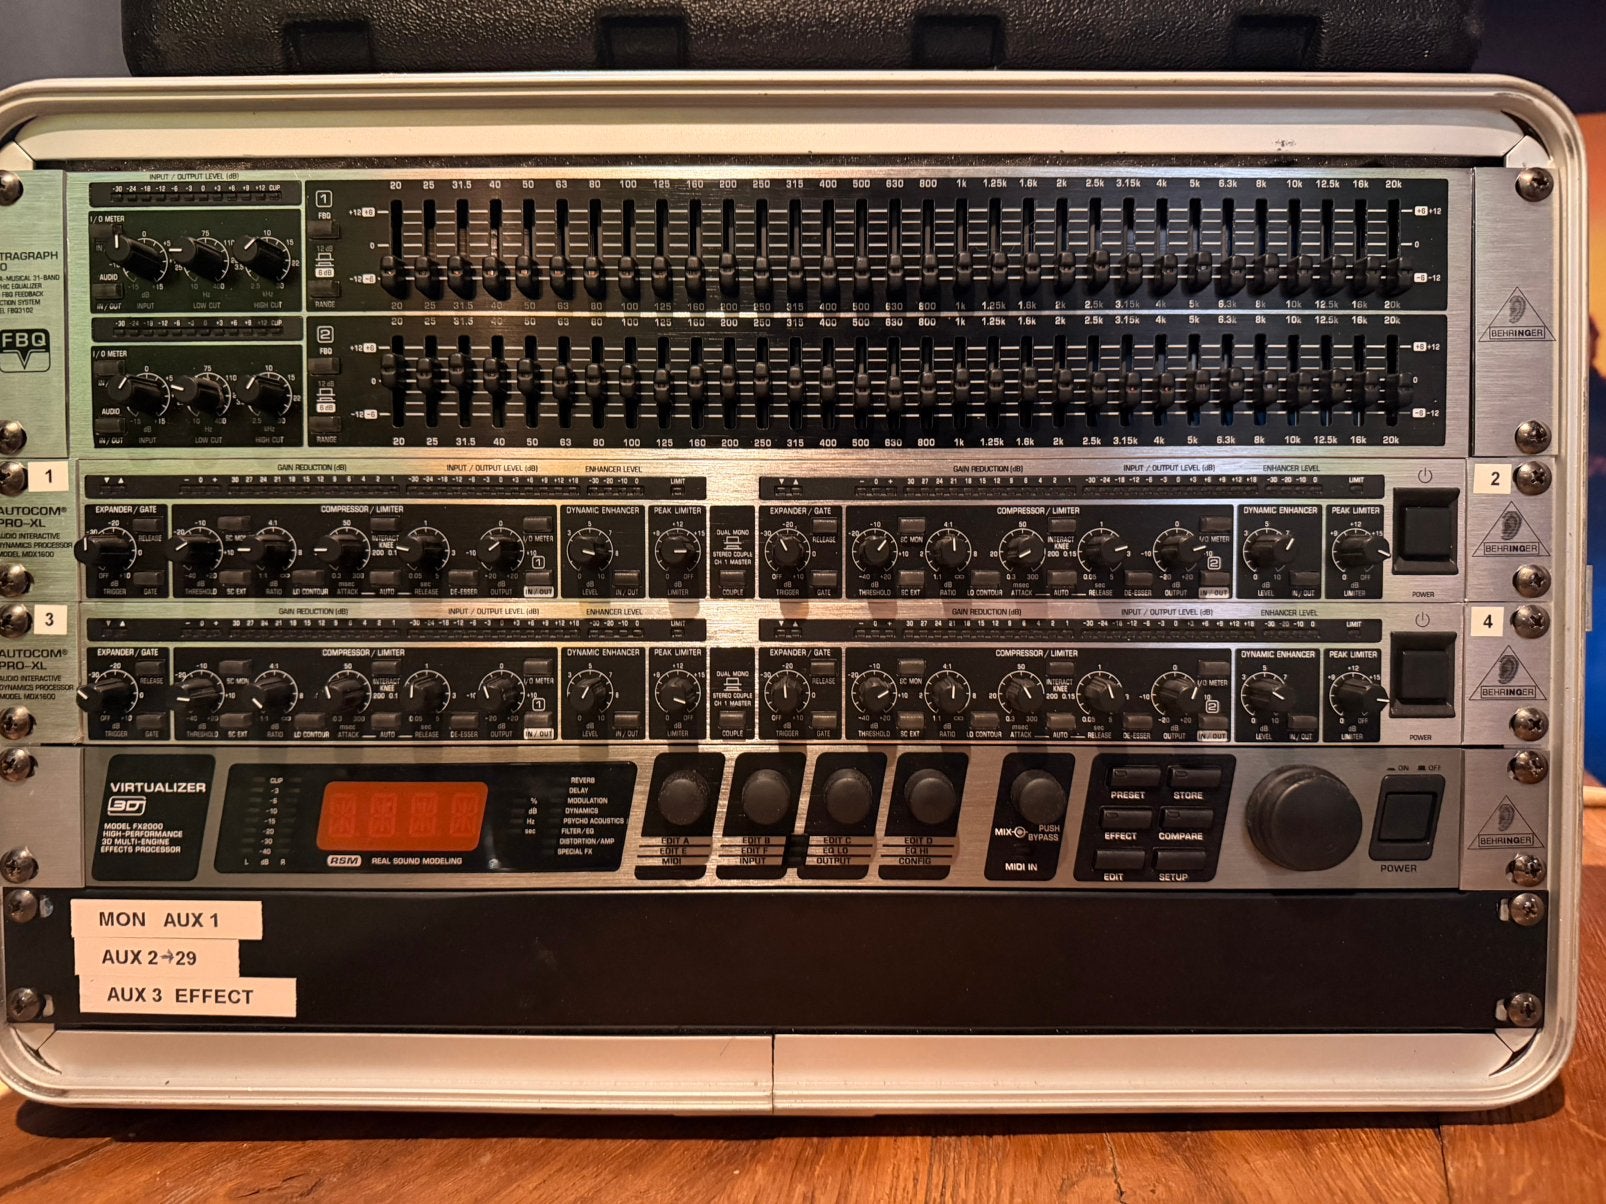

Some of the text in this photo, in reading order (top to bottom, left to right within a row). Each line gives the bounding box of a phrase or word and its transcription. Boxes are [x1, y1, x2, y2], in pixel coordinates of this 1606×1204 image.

[390, 179, 1401, 190] 20 25 31.5 40 50 63 80 100 125 160 200 250 315 400 500 630 800 1k 1.25k 1.6k 2k 2.5k 3.15k 4k 5k 6.3k 8k 10k 12.5k 16k 20k
[1491, 329, 1543, 338] BEHRINGER
[2, 332, 46, 347] FBQ
[393, 436, 1398, 448] 20 31.5 50 80 125 200 315 500 800 1.25k 2k 3.15k 5k 8k 12.5k 20k
[46, 469, 52, 483] 1
[1491, 472, 1499, 485] 2
[602, 507, 639, 515] ENHANCER
[654, 507, 701, 515] PEAK LIMITER
[1279, 507, 1317, 515] ENHANCER
[1332, 507, 1379, 515] PEAK LIMITER
[1485, 544, 1537, 553] BEHRINGER
[46, 613, 53, 626] 3
[1484, 615, 1493, 628] 4
[567, 648, 640, 657] DYNAMIC ENHANCER
[654, 648, 702, 657] PEAK LIMITER
[1277, 651, 1315, 659] ENHANCER
[1330, 651, 1377, 659] PEAK LIMITER
[0, 661, 47, 670] PRO-XL
[1482, 687, 1535, 697] BEHRINGER
[111, 783, 205, 792] VIRTUALIZER
[1111, 792, 1144, 800] PRESET
[1174, 792, 1203, 800] STORE
[568, 797, 608, 805] MODULATION
[104, 823, 163, 831] MODEL FX2000
[1039, 825, 1059, 833] PUSH
[995, 828, 1012, 836] MIX
[661, 837, 690, 845] EDIT A
[742, 837, 771, 845] EDIT B
[823, 837, 852, 845] EDIT C
[904, 837, 933, 845] EDIT D
[1028, 834, 1058, 842] BYPASS
[1105, 833, 1136, 841] EFFECT
[1159, 833, 1202, 841] COMPARE
[1480, 835, 1532, 845] BEHRINGER
[115, 838, 169, 846] MULTI-ENGINE
[101, 846, 180, 854] EFFECTS PROCESSOR
[558, 848, 582, 856] SPECIAL
[330, 857, 359, 865] RSM
[662, 857, 682, 865] MIDI
[740, 857, 766, 865] INPUT
[816, 857, 851, 865] OUTPUT
[899, 857, 932, 865] CONFIG
[1006, 863, 1025, 871] MIDI
[1104, 873, 1123, 881] EDIT
[1160, 874, 1187, 882] SETUP
[100, 912, 217, 927] MON AUX 1
[102, 950, 142, 964] AUX
[108, 987, 253, 1004] AUX 3 EFFECT
